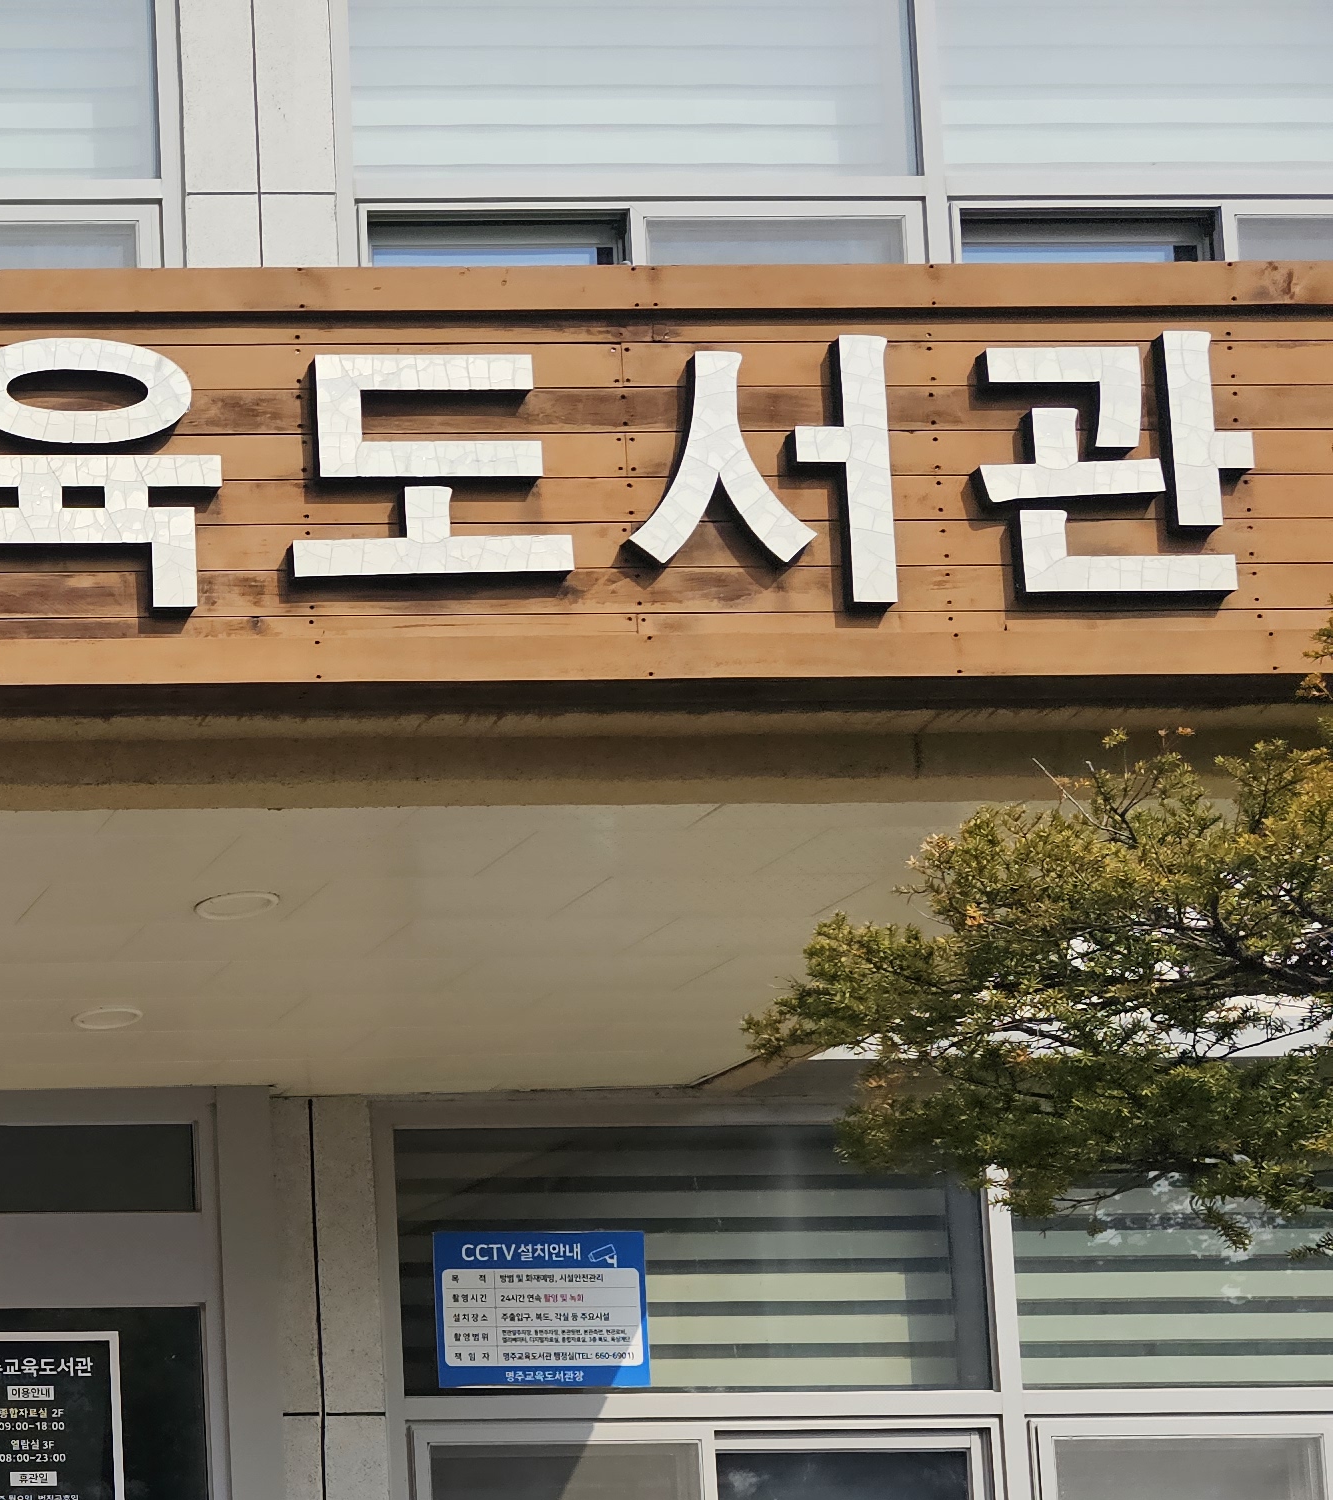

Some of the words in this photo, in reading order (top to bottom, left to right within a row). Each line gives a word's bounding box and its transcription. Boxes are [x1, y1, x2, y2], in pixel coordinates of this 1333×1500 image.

[462, 1244, 514, 1261] CCTV
[518, 1243, 582, 1262] 설치안내
[503, 1351, 552, 1361] 명주교육도서관
[505, 1371, 584, 1383] 명주교육도서관장
[11, 1387, 51, 1399] 이용안내
[0, 1408, 47, 1419] 종합자료실
[51, 1409, 64, 1418] 2F
[10, 1439, 40, 1450] 열람실
[42, 1440, 55, 1450] 3F
[0, 1453, 66, 1463] 08:00-23:00
[19, 1473, 49, 1484] 휴관일
